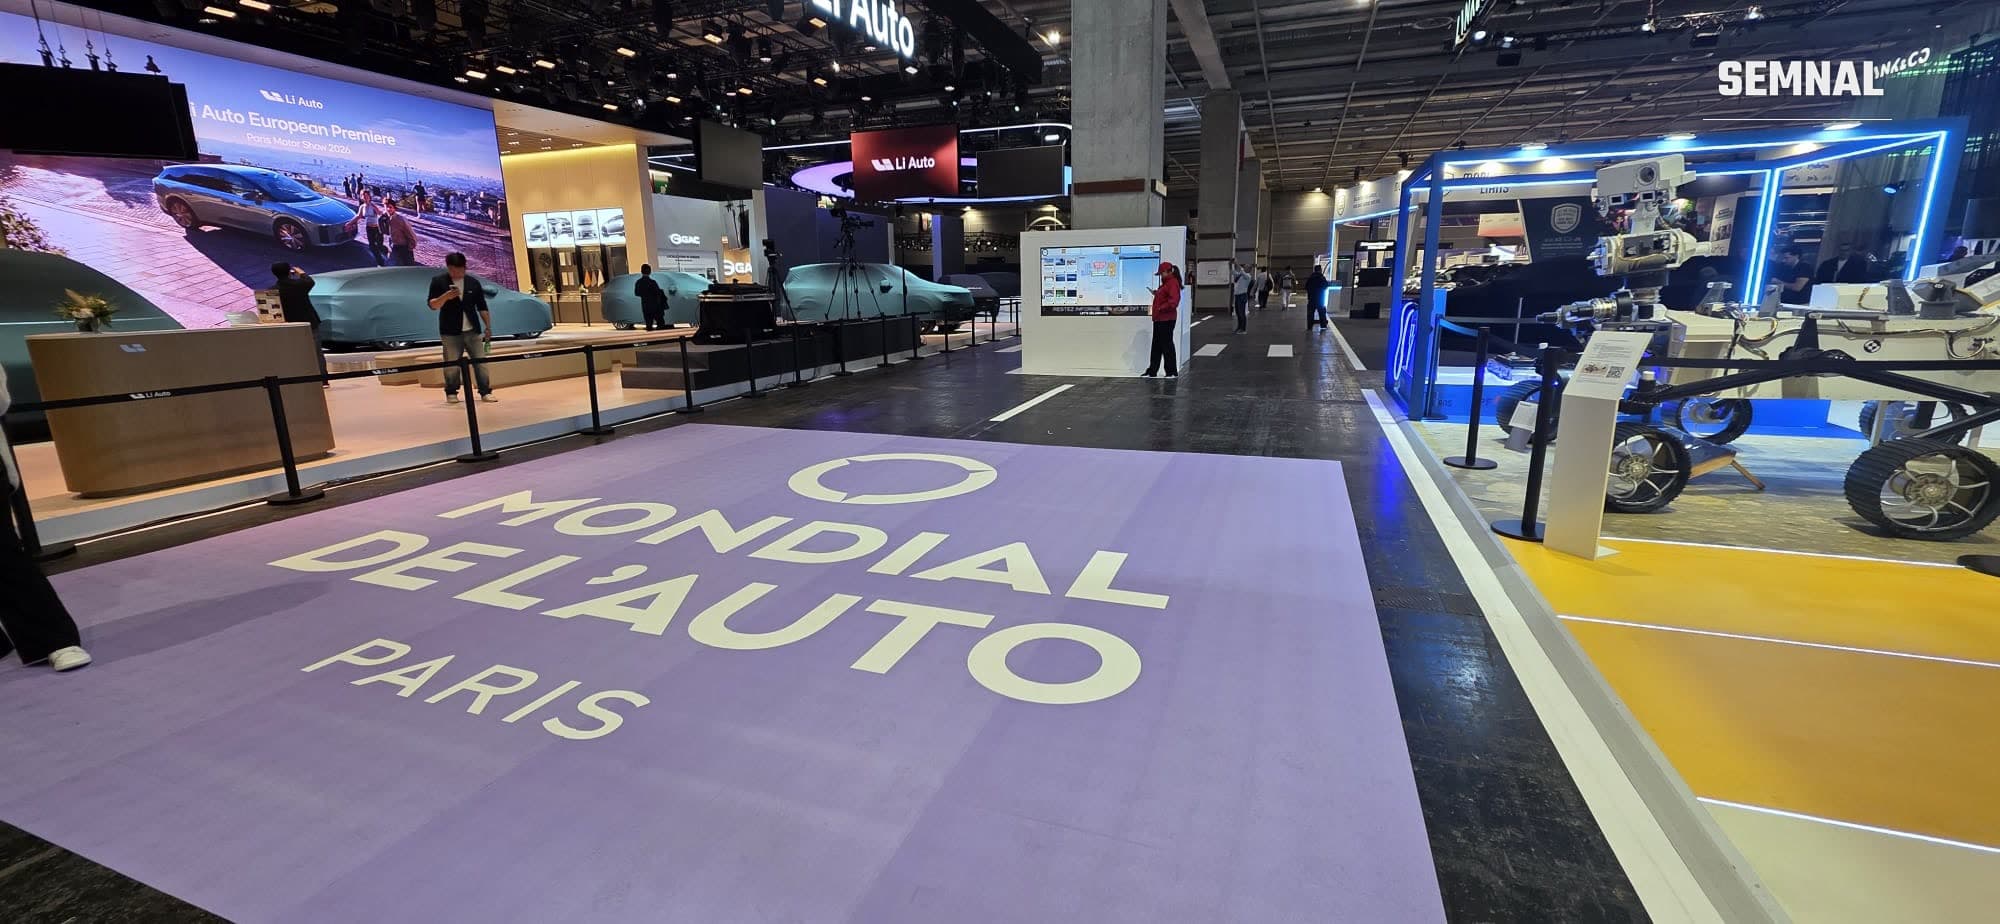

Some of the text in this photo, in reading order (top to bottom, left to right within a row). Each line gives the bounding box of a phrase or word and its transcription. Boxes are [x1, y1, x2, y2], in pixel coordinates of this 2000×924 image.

[850, 0, 914, 59] Auto
[202, 104, 245, 125] Auto
[248, 111, 329, 138] European
[332, 124, 396, 146] Premiere
[285, 94, 323, 110] Li Auto
[246, 132, 351, 155] Paris Motor Show 2026
[896, 156, 936, 170] Li Auto
[439, 489, 1170, 609] MONDIAL
[267, 529, 1142, 705] DE L'AUTO
[301, 637, 651, 741] PARIS
